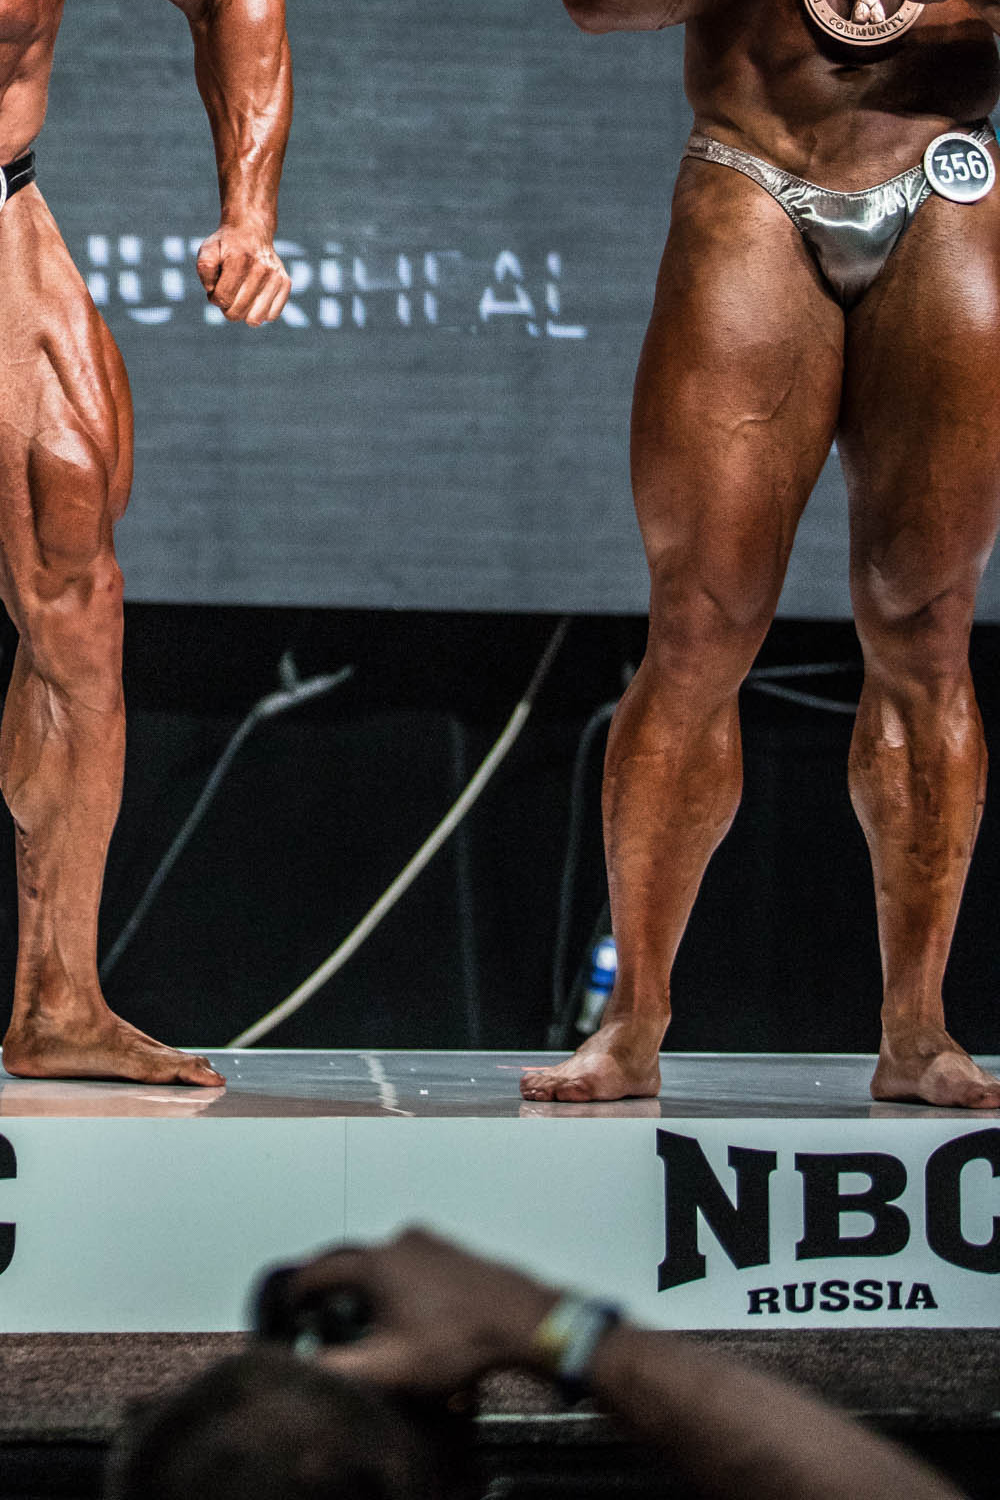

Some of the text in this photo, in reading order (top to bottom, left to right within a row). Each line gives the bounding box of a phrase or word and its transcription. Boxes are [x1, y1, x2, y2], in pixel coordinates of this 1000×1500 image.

[828, 14, 904, 36] COMMUNITY
[934, 150, 986, 184] 356
[656, 1128, 1000, 1292] NBC
[747, 1280, 938, 1315] RUSSIA
